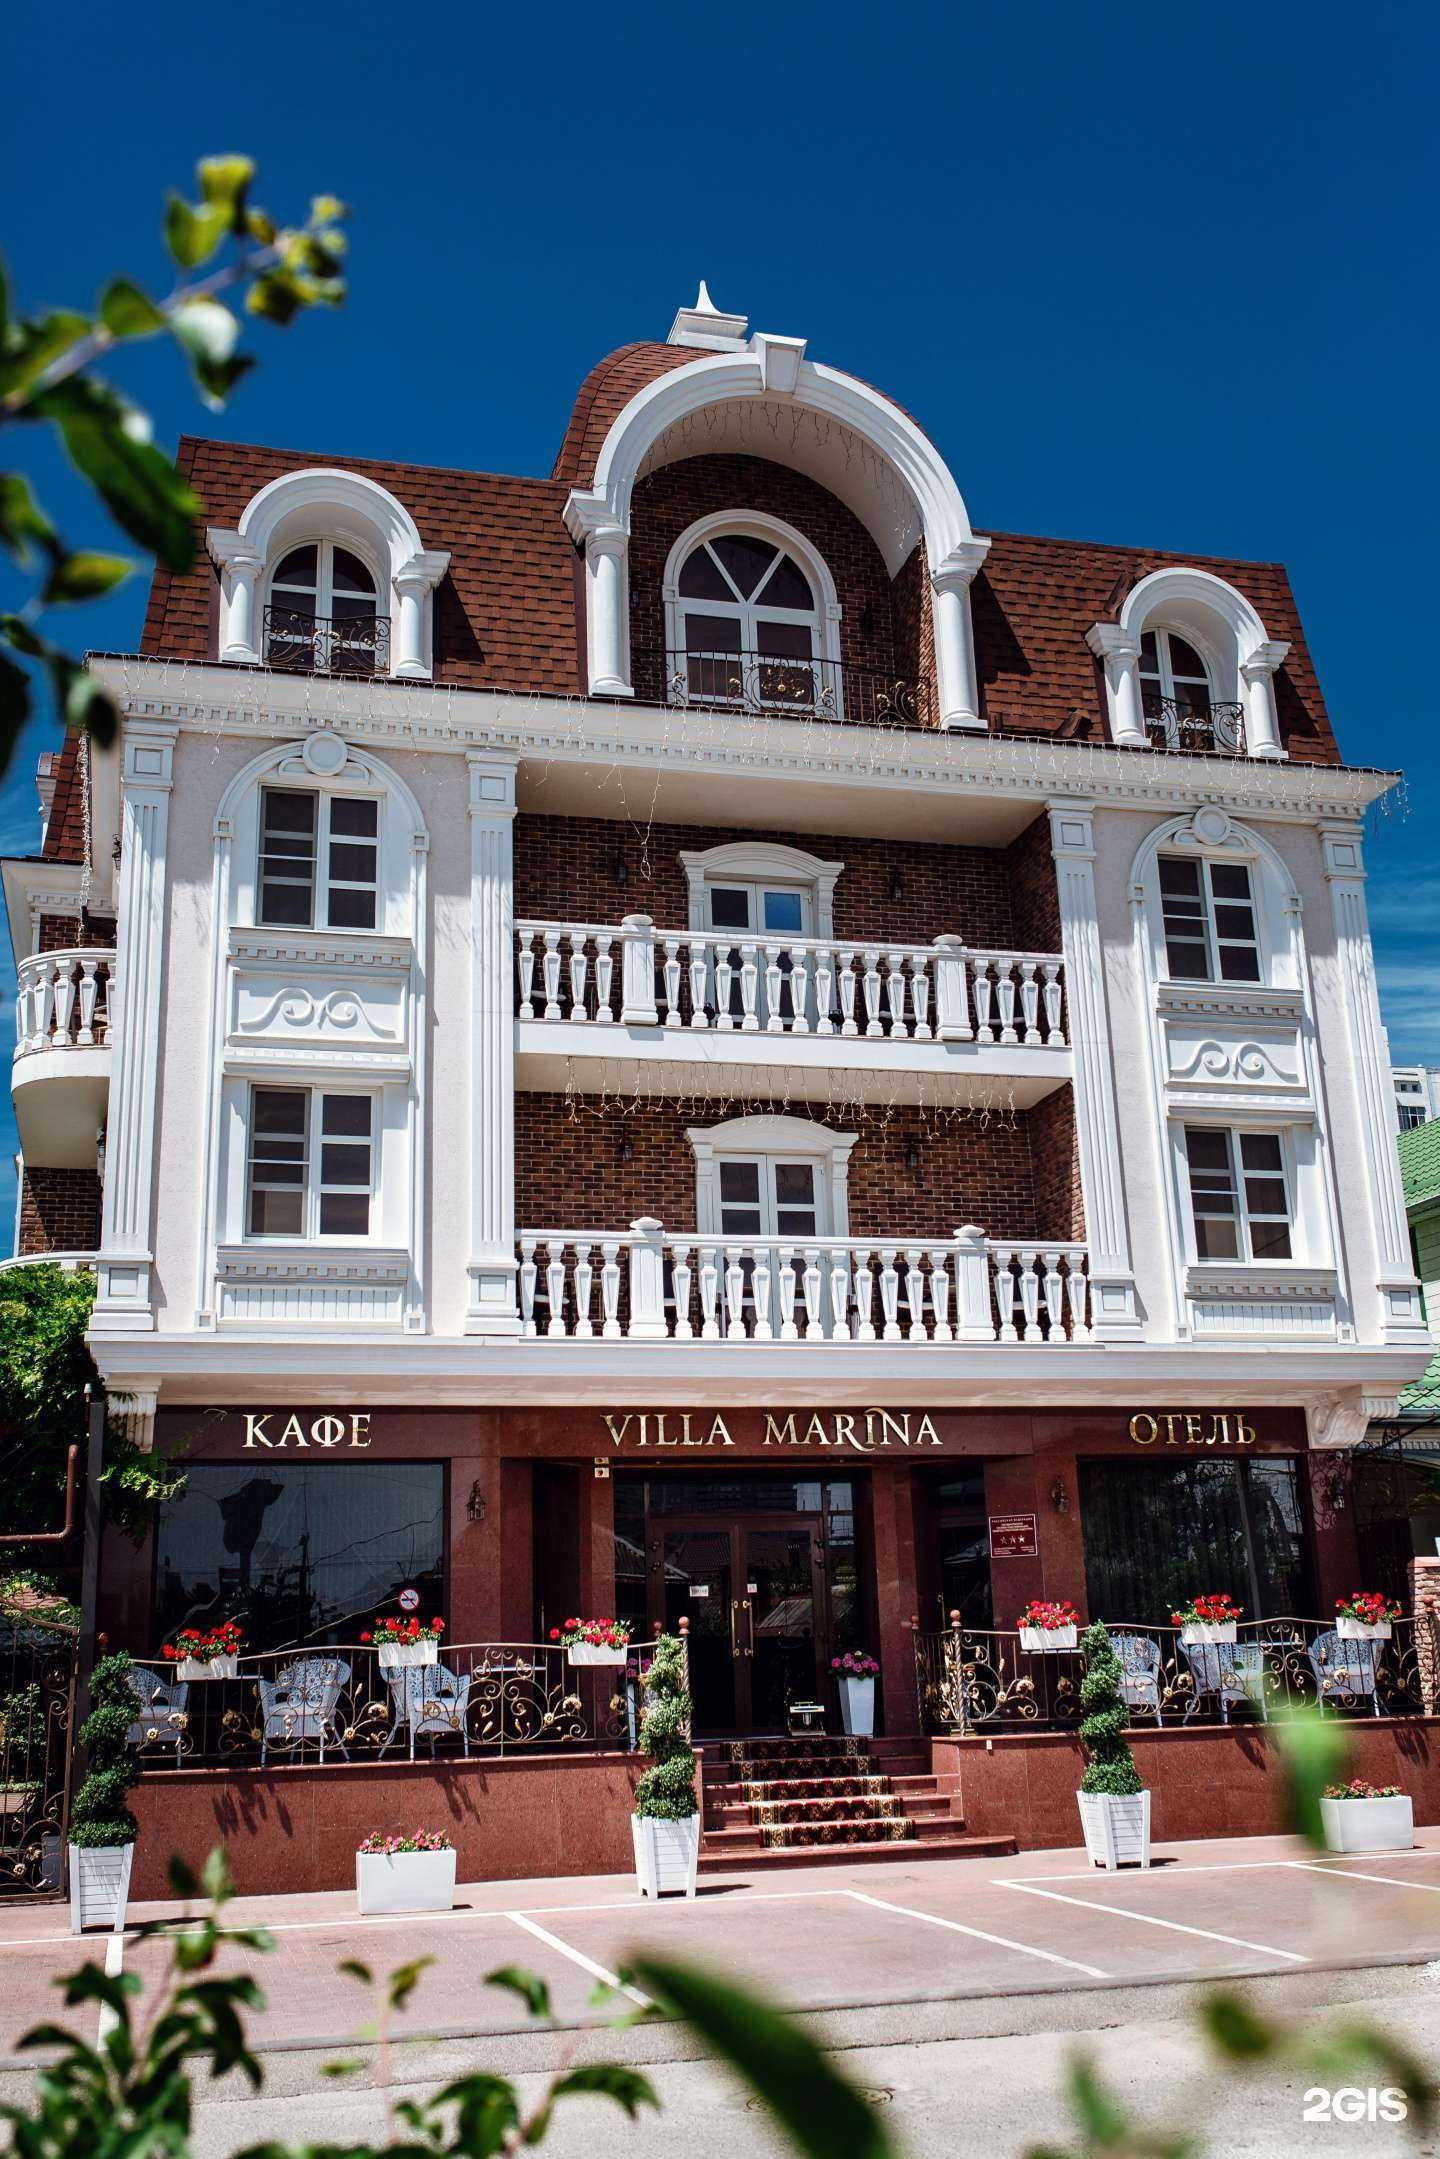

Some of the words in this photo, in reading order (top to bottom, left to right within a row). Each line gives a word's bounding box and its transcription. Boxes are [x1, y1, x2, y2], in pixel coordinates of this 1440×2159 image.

[241, 1413, 372, 1448] КАФЕ
[600, 1413, 736, 1447] VILLA
[761, 1407, 944, 1452] MARINA
[1129, 1412, 1256, 1445] ОТЕЛЬ
